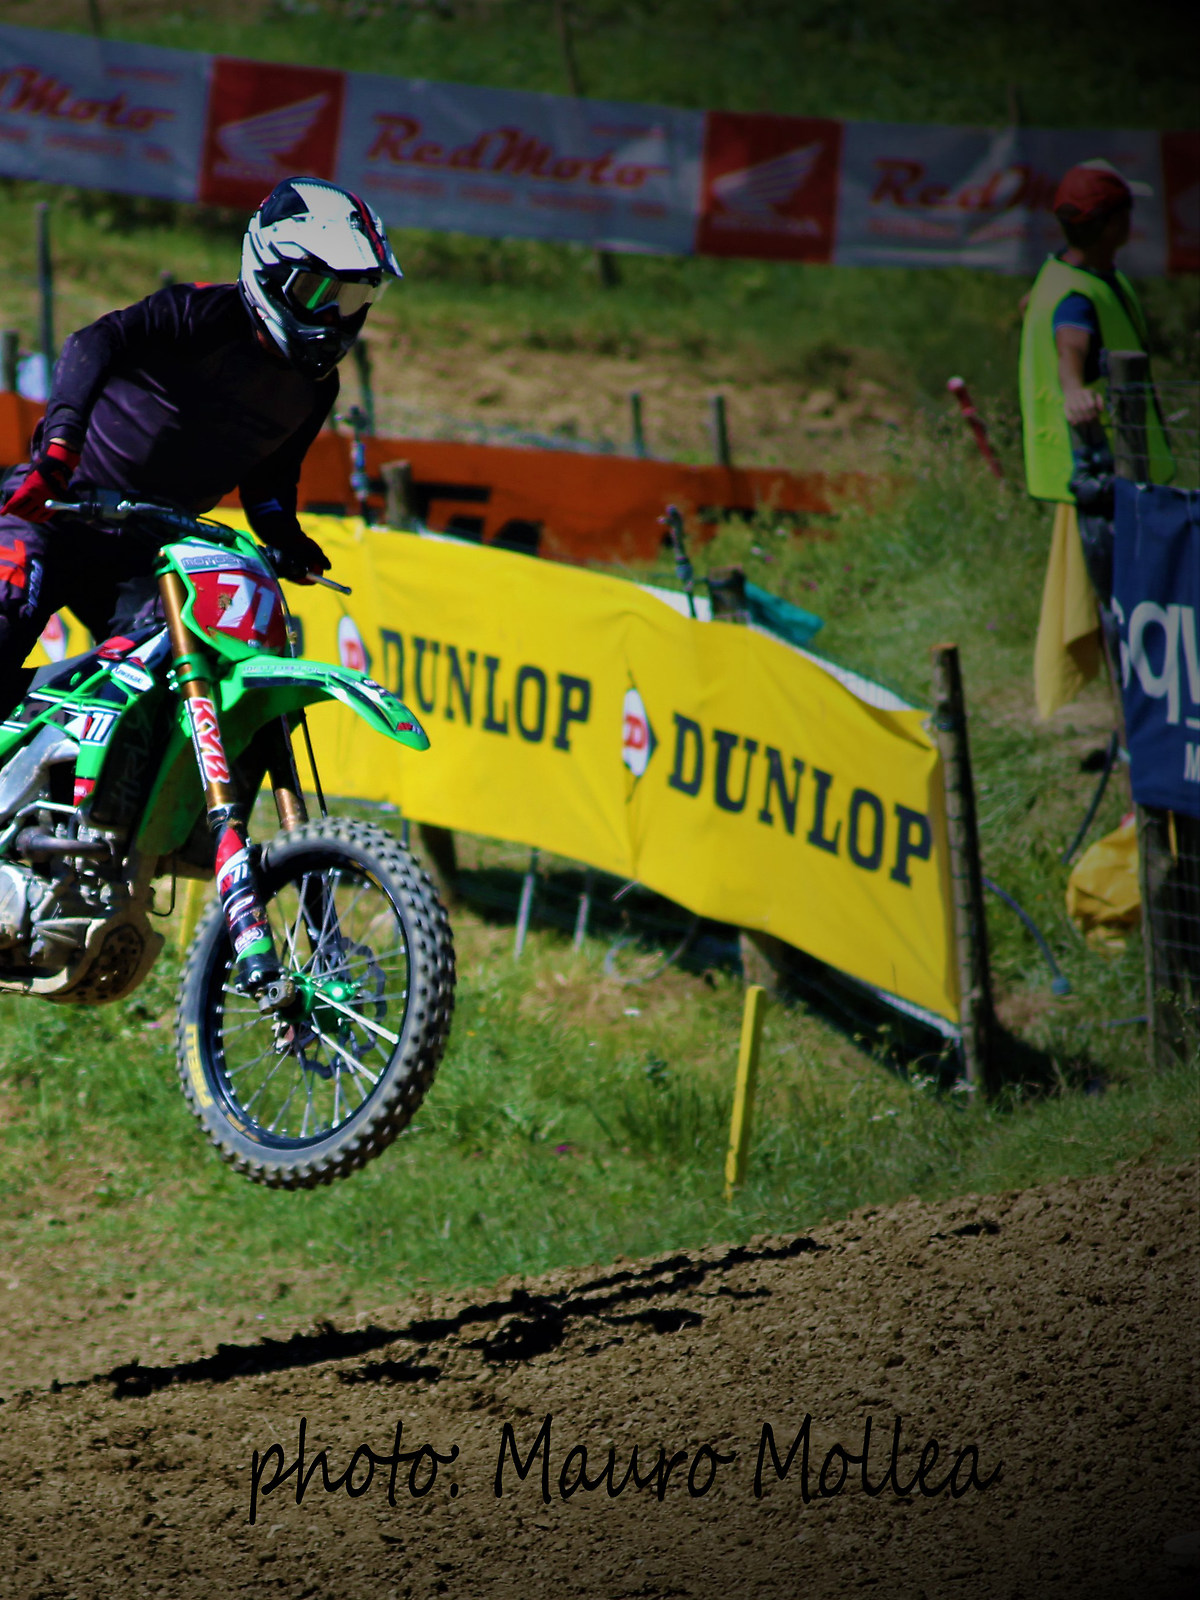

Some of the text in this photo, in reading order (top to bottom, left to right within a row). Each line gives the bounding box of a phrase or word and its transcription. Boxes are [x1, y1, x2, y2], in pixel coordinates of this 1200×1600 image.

[366, 112, 670, 189] RedMoto
[216, 572, 276, 636] 71
[189, 698, 231, 783] KYB
[378, 627, 592, 753] DUNLOP
[668, 711, 933, 887] DUNLOP
